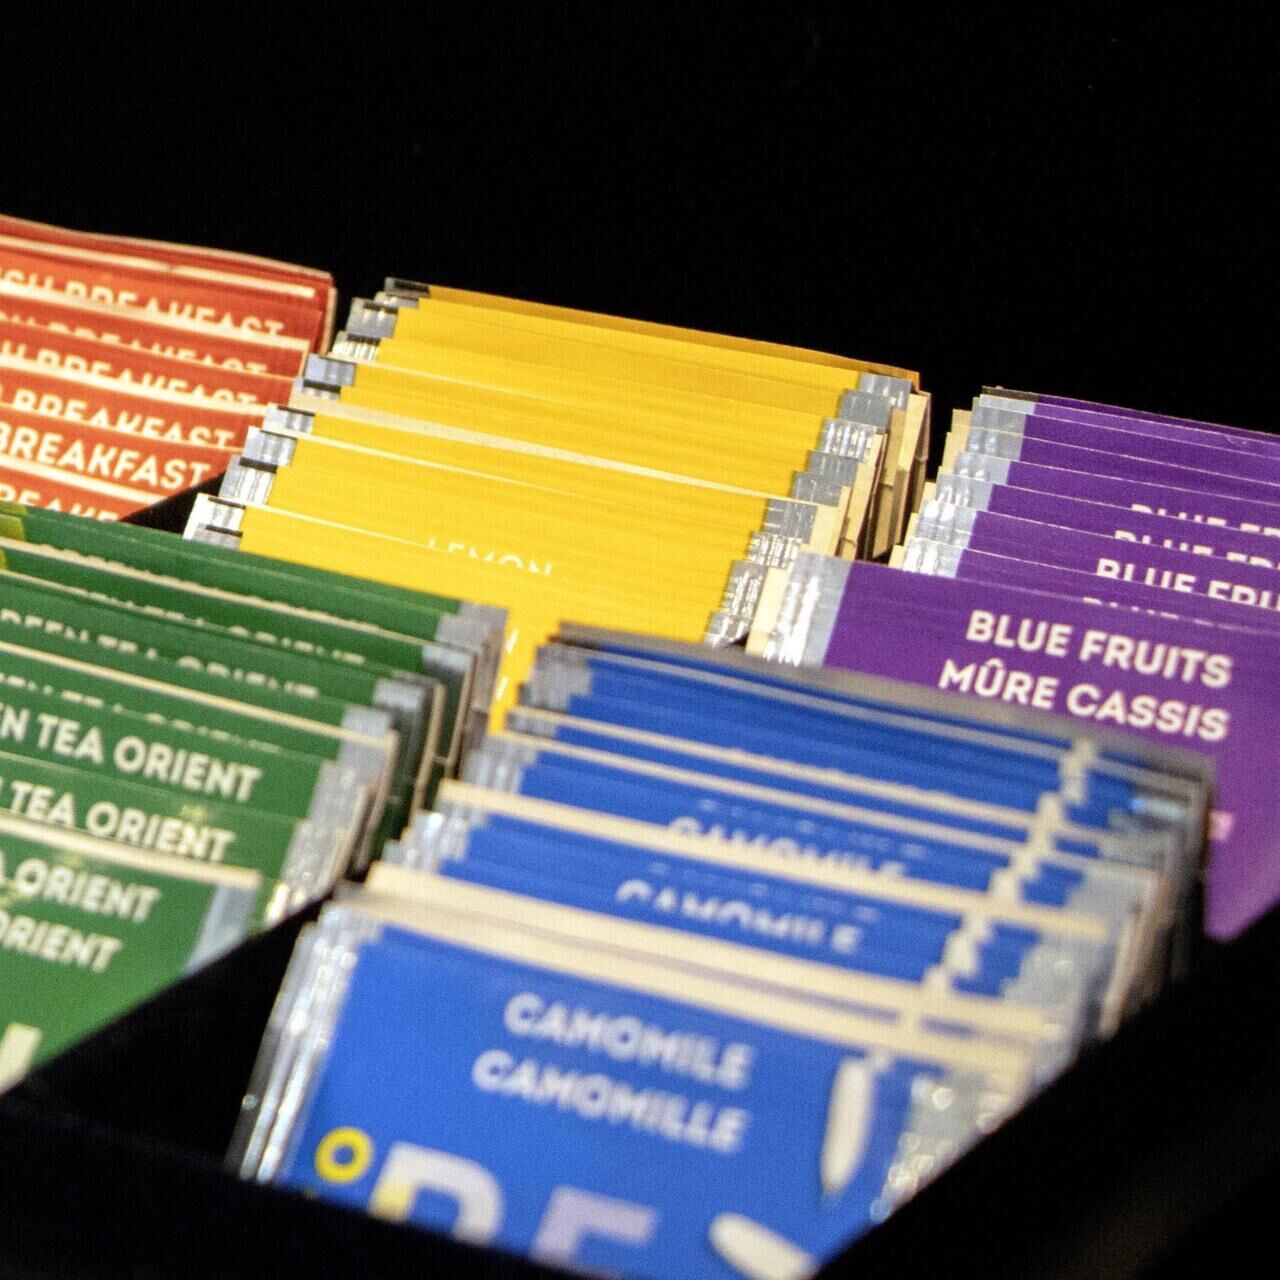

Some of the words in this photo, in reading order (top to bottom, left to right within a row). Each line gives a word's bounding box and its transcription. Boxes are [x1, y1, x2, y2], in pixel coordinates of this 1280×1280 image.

[965, 609, 1073, 658] BLUE
[1078, 629, 1234, 689] FRUITS
[938, 657, 1060, 710] MÛRE
[1065, 683, 1230, 742] CASSIS
[36, 713, 106, 765] TEA
[113, 735, 265, 803] ORIENT
[9, 779, 77, 829] TEA
[84, 800, 237, 864] ORIENT
[13, 857, 162, 923] ORIENT
[503, 991, 755, 1091] CAMOMILE
[471, 1048, 750, 1154] CAMOMILLE
